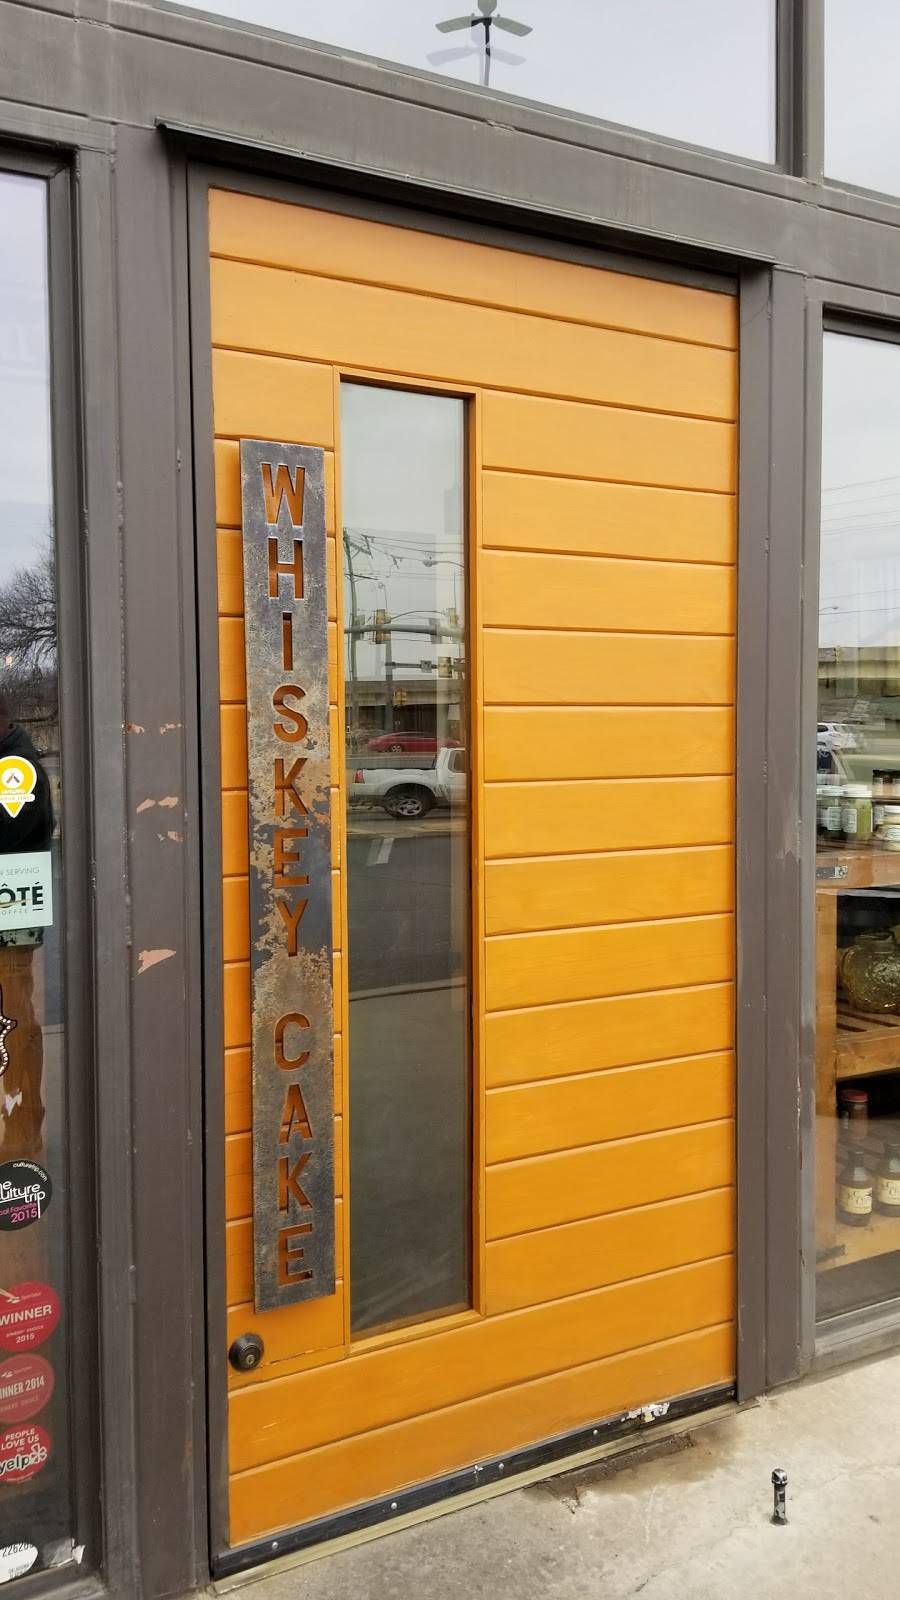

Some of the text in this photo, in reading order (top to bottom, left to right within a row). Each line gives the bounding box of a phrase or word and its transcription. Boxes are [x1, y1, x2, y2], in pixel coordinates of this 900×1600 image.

[7, 866, 40, 876] SERVING
[261, 462, 313, 1288] WHISKEY CAKE
[25, 1190, 46, 1219] trip
[11, 1207, 38, 1223] 2015
[0, 1304, 53, 1326] WINNER
[15, 1332, 36, 1344] 2015
[25, 1375, 45, 1392] 2014
[1, 1434, 40, 1451] LOVE US
[5, 1428, 35, 1441] PEOPLE
[0, 1455, 30, 1475] yelp
